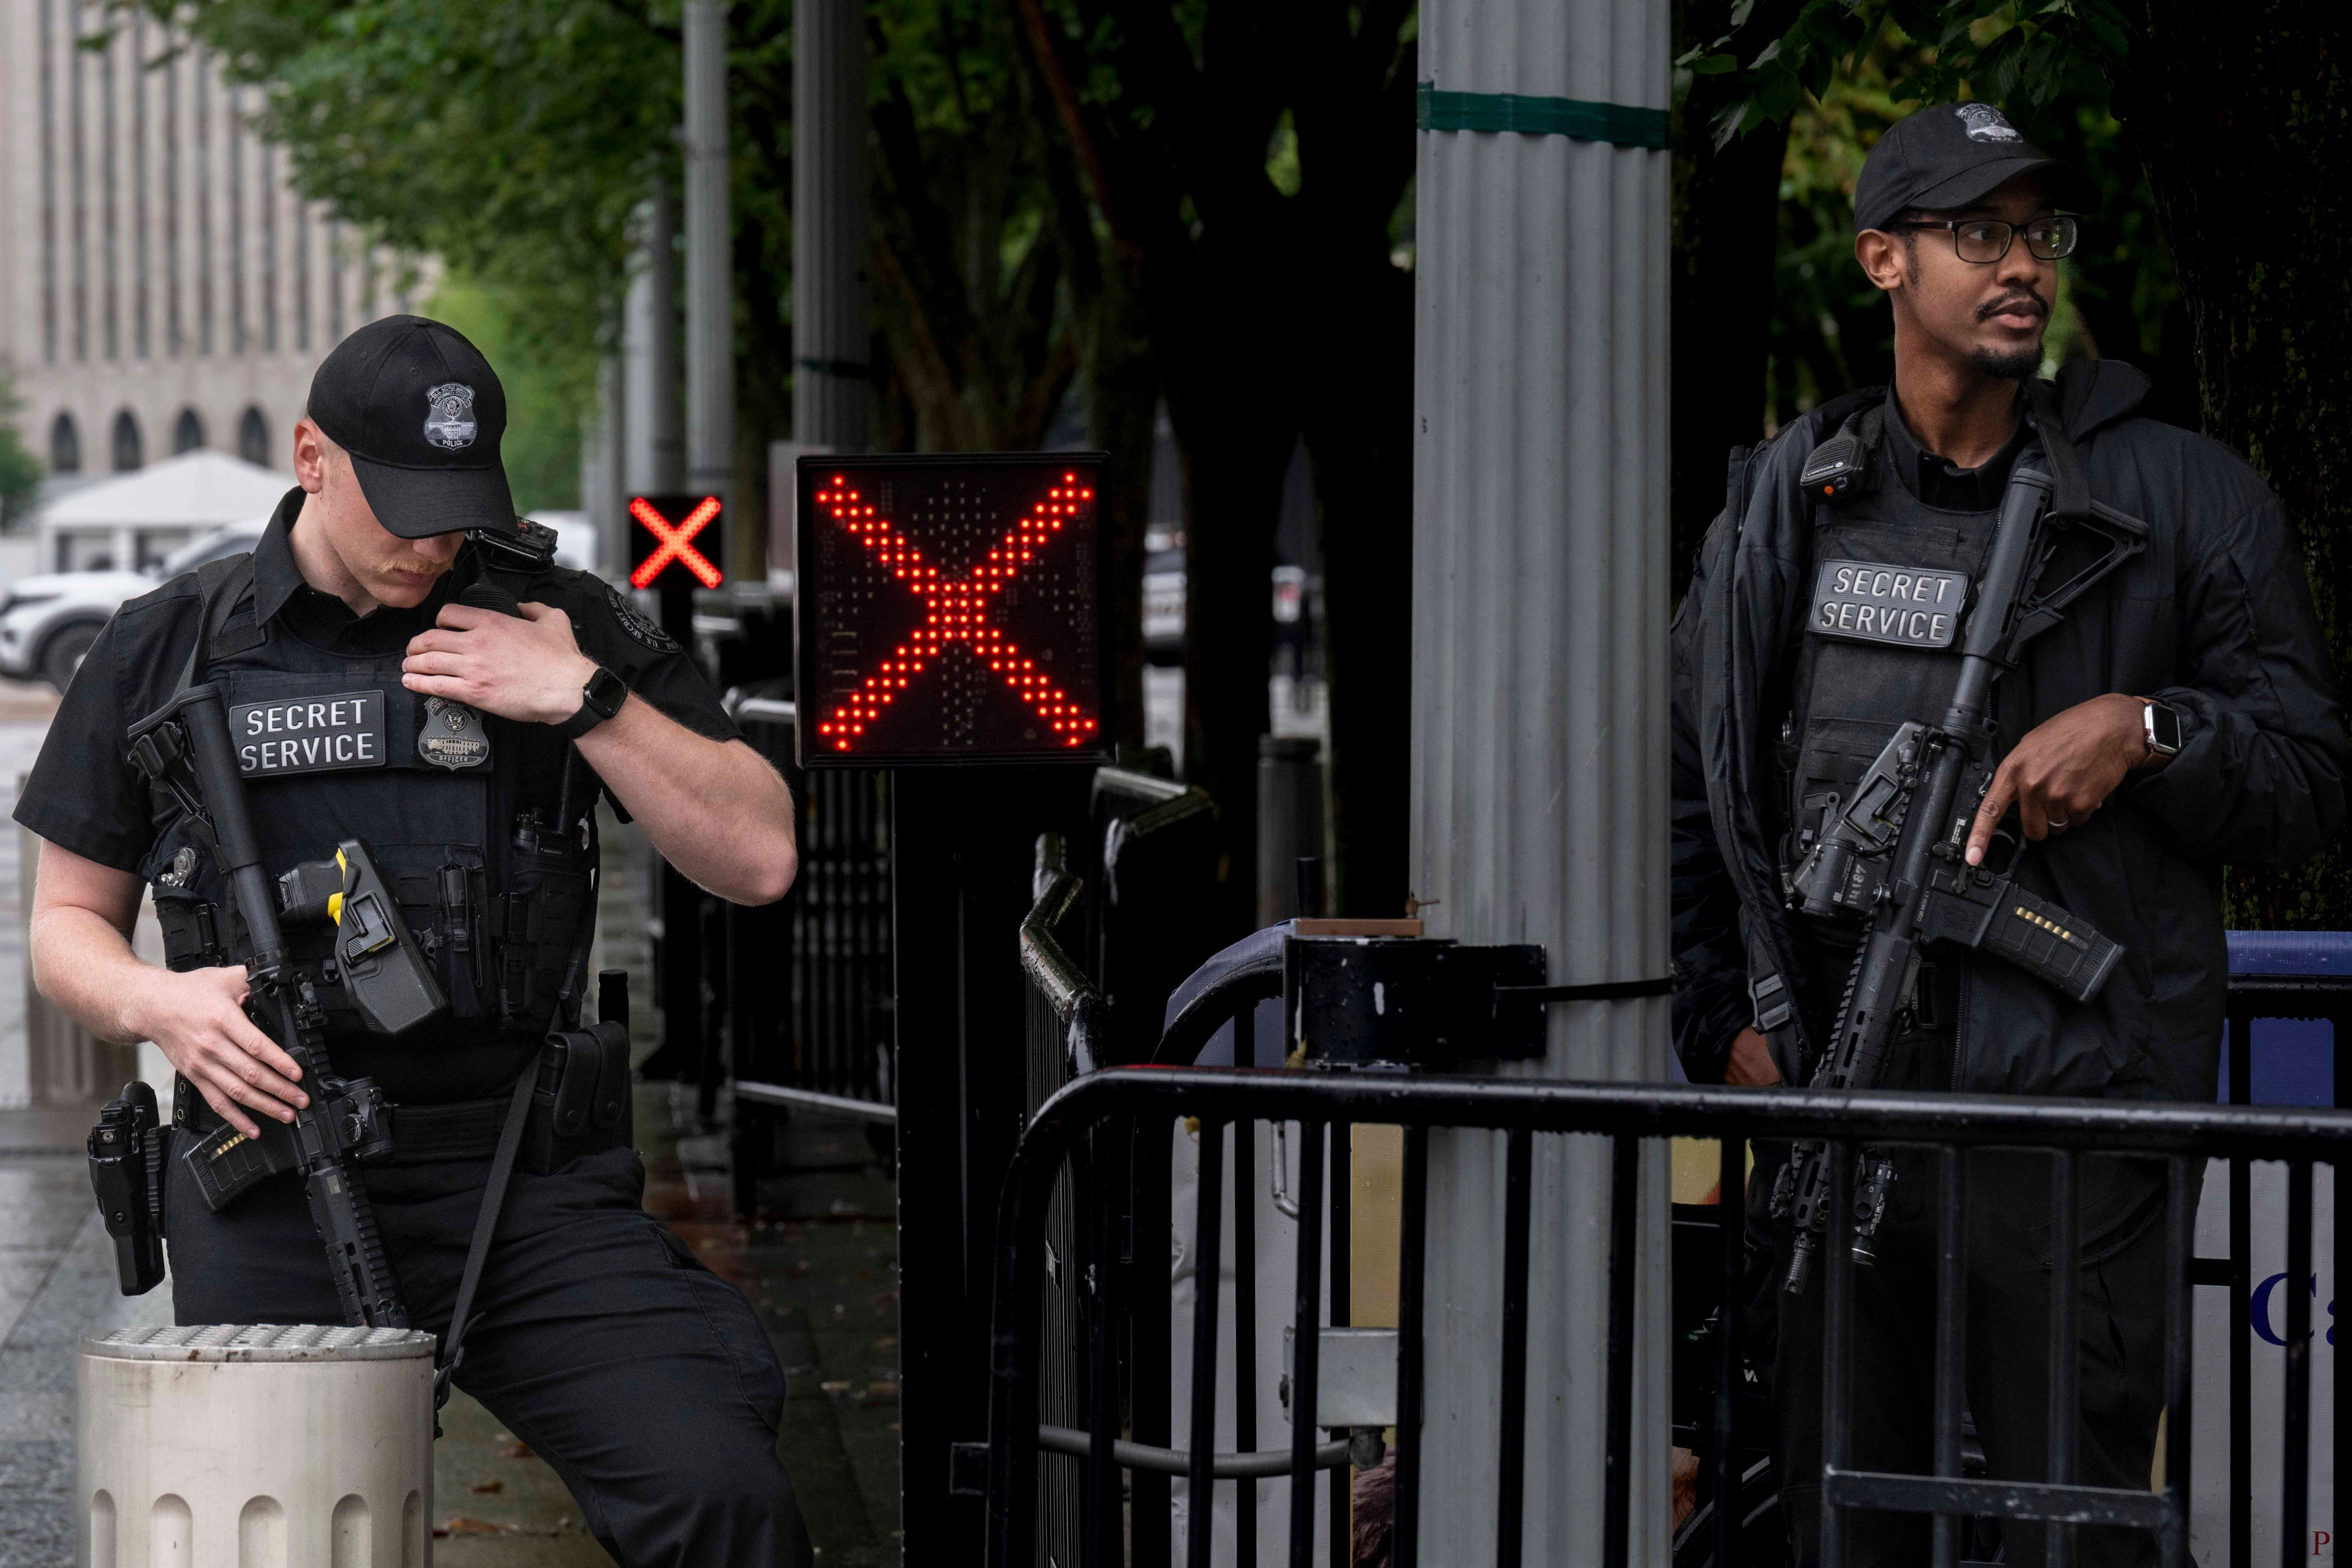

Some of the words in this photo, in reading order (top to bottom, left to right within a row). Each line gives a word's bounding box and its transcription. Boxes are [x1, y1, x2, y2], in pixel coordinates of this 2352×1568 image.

[1833, 568, 1952, 603] SECRET
[616, 611, 643, 639] SECRET
[1820, 602, 1947, 640] SERVICE
[645, 636, 659, 648] U.S.
[246, 698, 367, 735] SECRET
[240, 733, 373, 771] SERVICE
[1847, 864, 1866, 904] 14187
[2311, 1531, 2333, 1556] P
